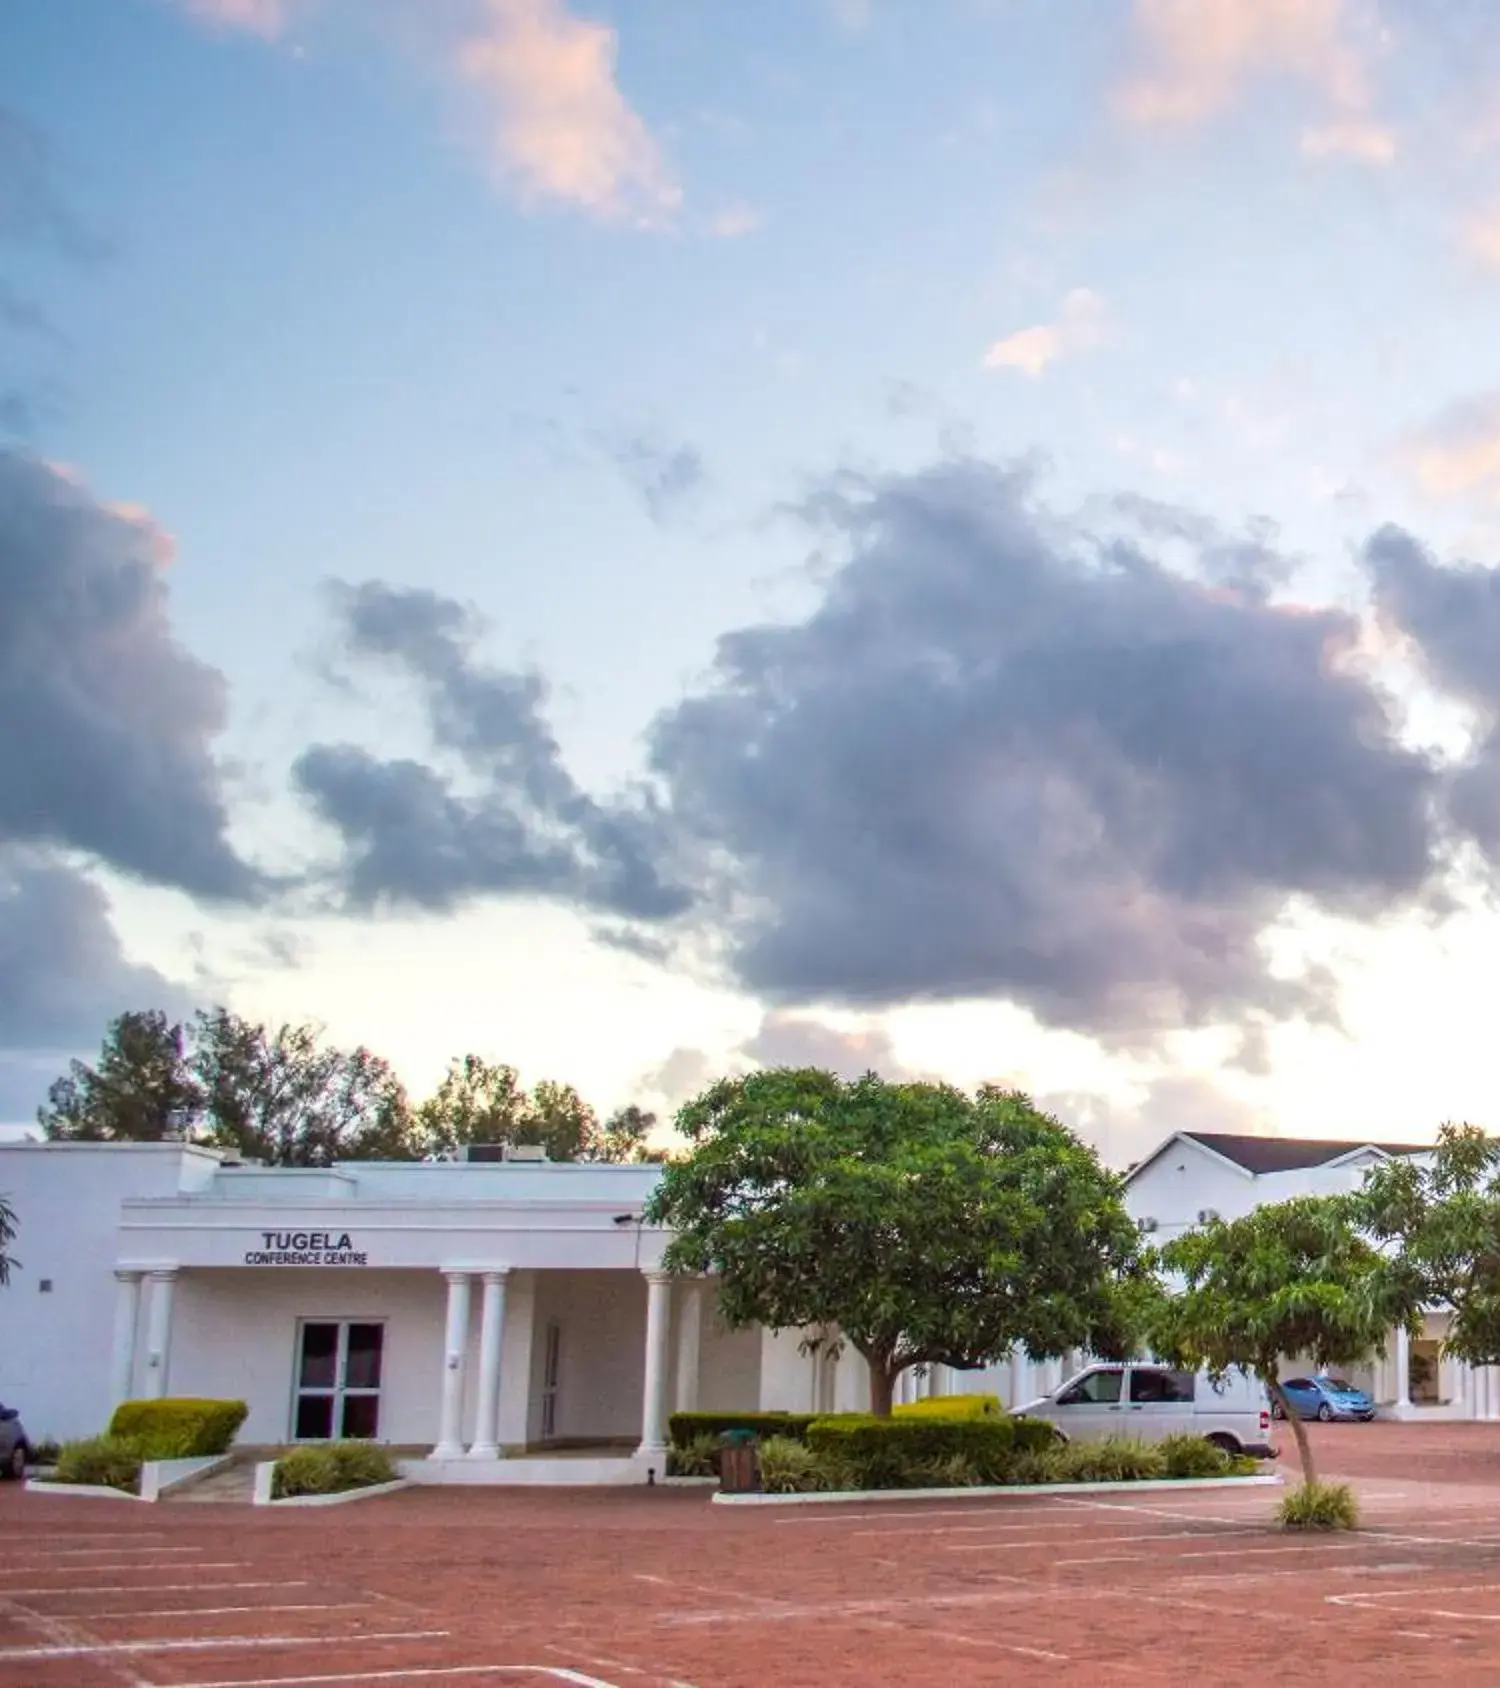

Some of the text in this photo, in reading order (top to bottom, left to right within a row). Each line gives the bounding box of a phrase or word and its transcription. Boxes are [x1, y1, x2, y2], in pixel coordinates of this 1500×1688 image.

[262, 1233, 352, 1250] TUGELA
[245, 1252, 368, 1265] CONFERENCE CENTRE
